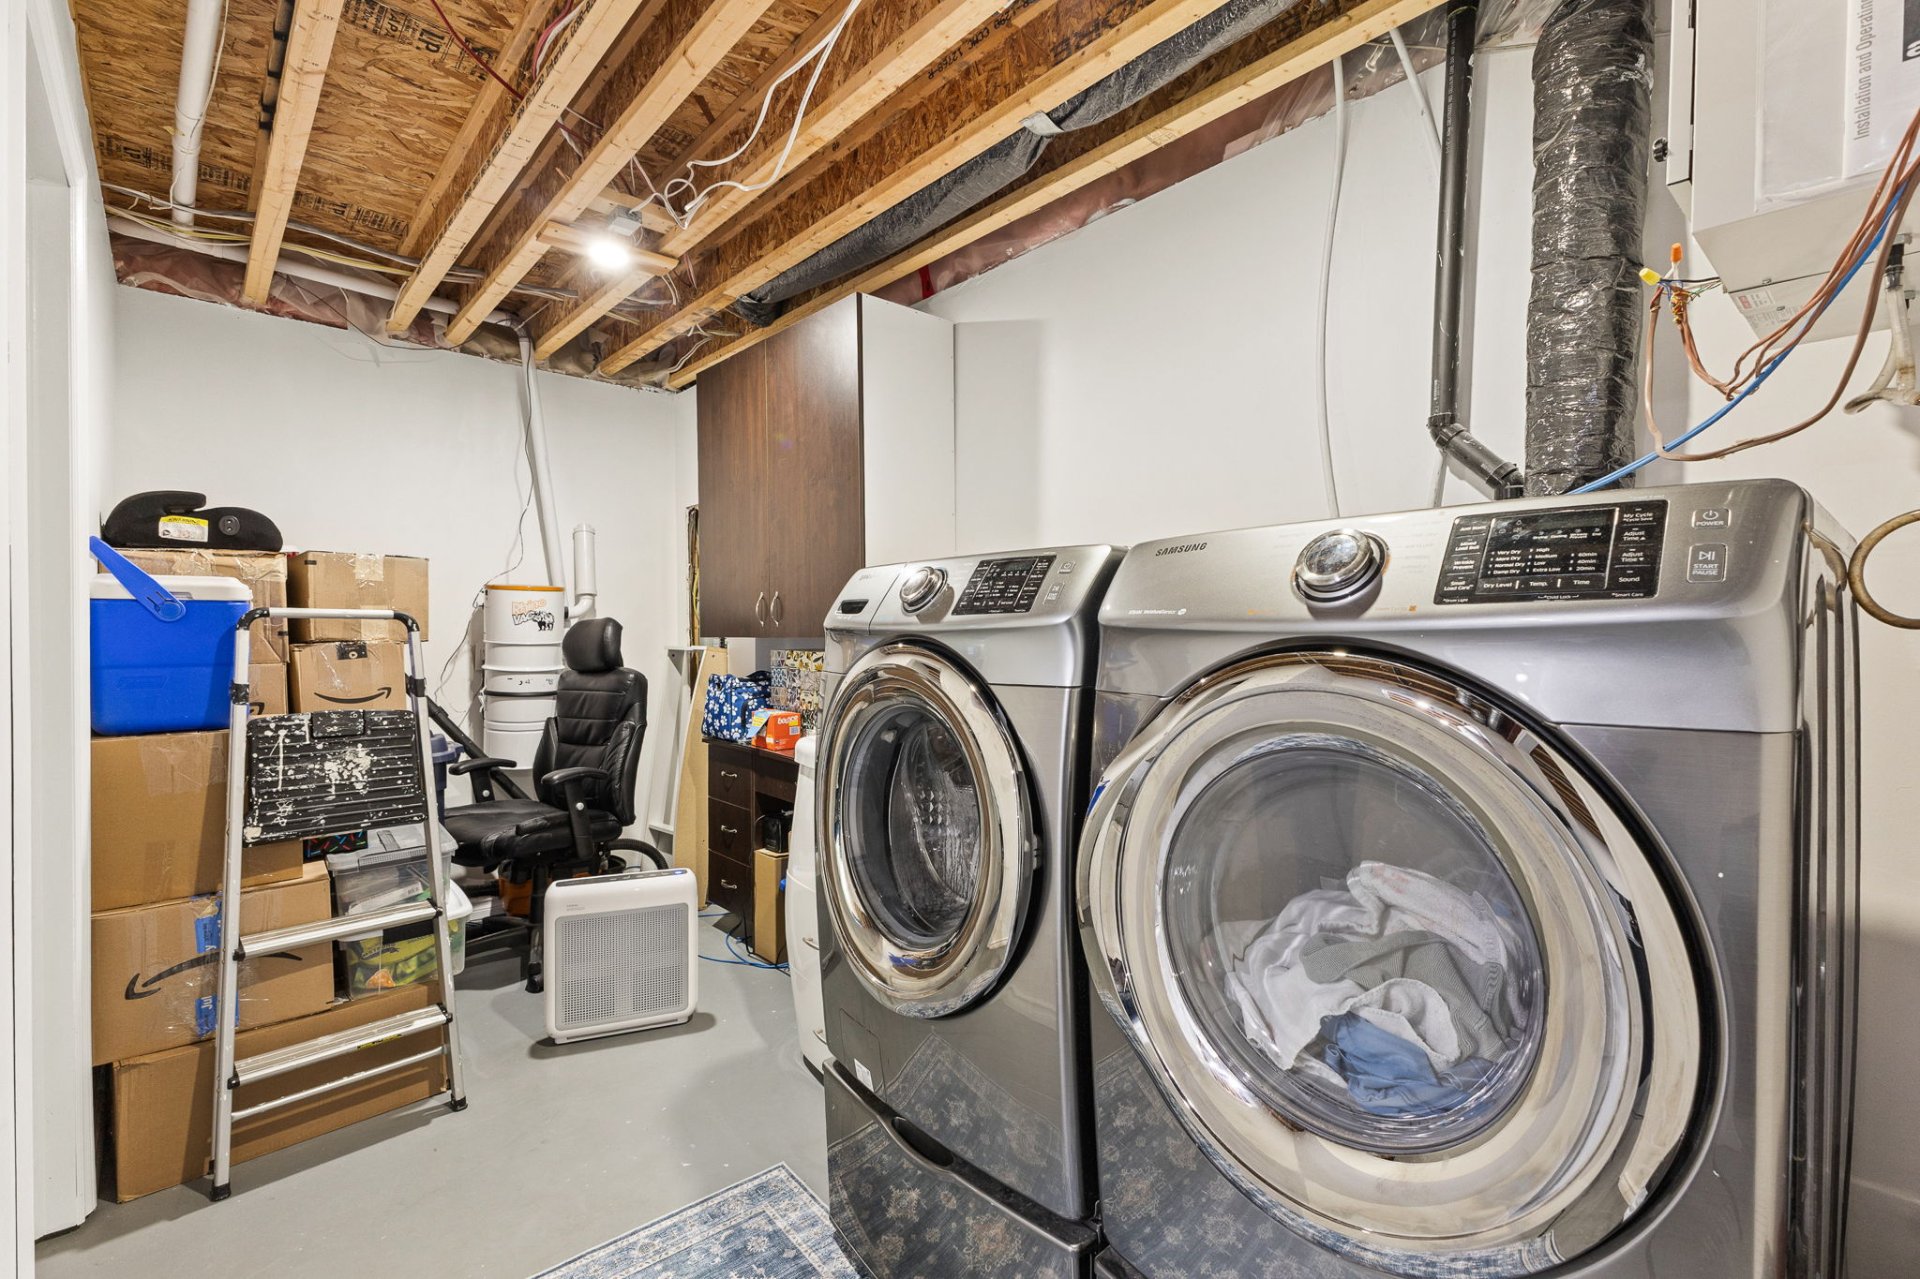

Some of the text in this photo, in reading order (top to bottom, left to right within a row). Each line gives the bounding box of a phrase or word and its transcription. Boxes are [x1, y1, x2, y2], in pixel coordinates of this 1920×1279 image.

[1856, 52, 1873, 74] and
[1853, 75, 1872, 141] Installation
[1155, 542, 1208, 557] SAMSUNG
